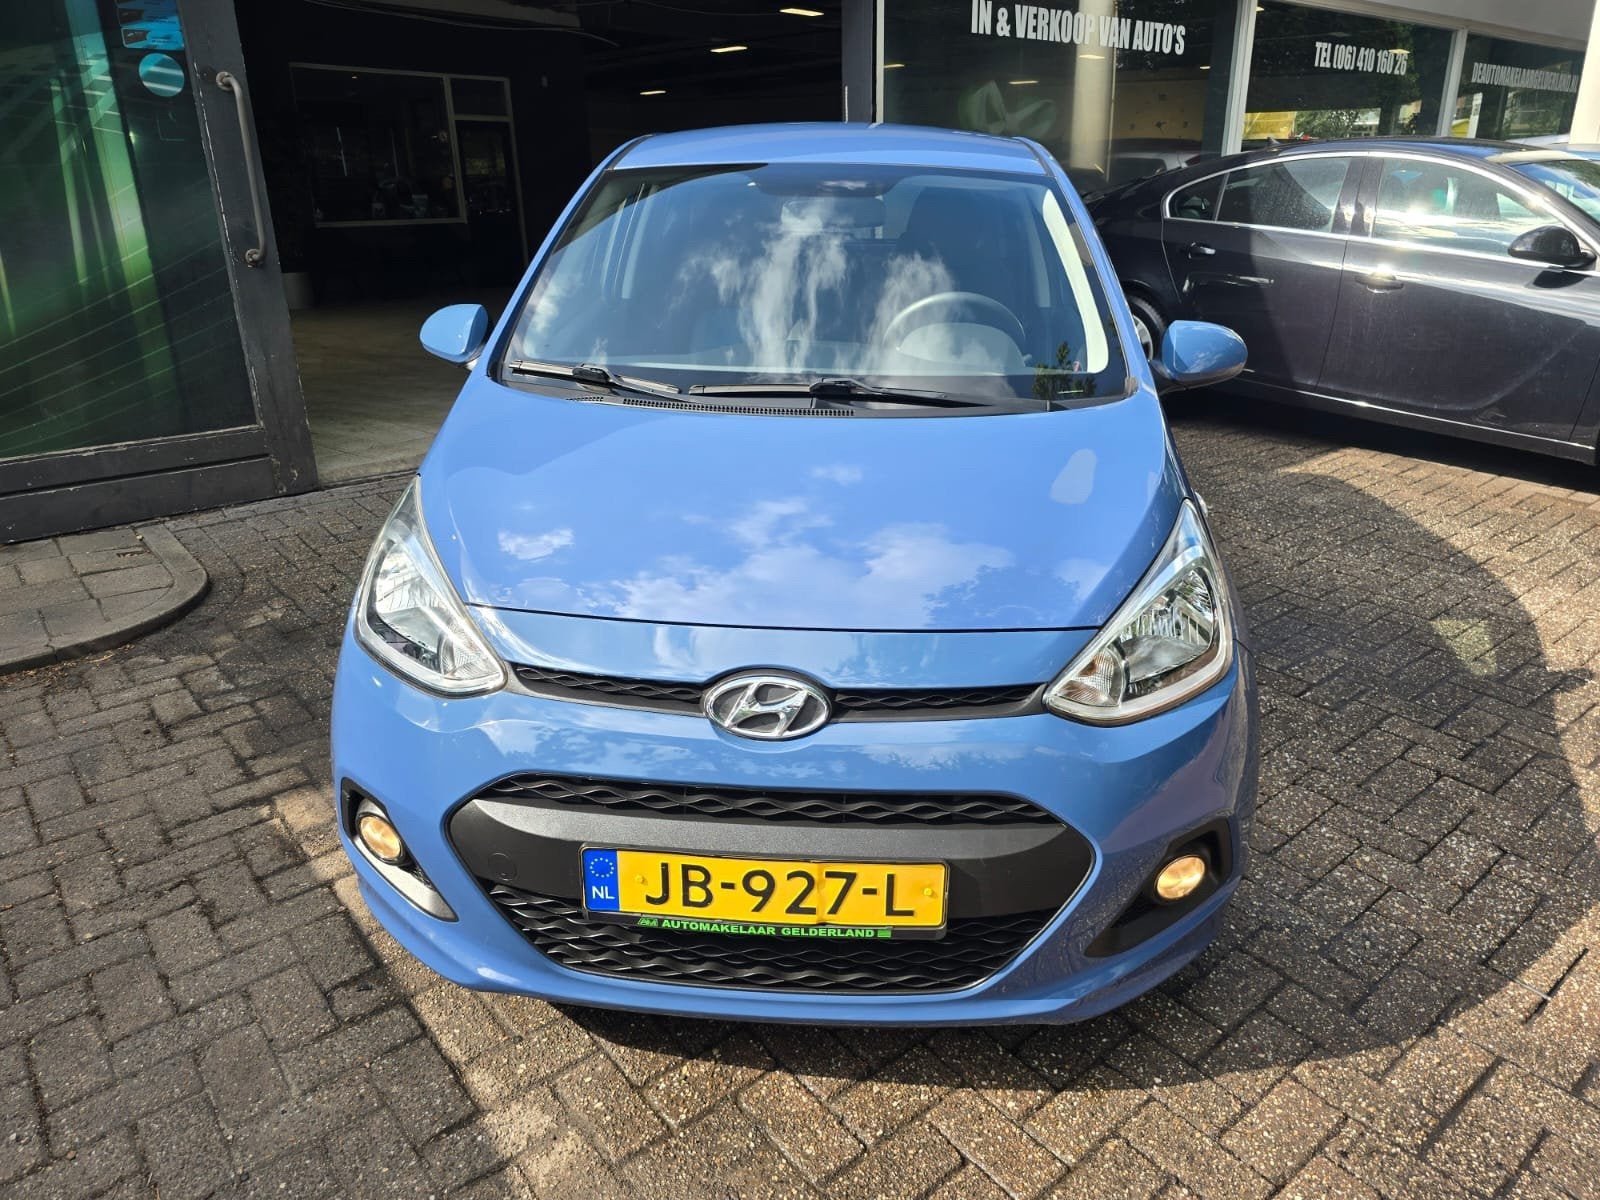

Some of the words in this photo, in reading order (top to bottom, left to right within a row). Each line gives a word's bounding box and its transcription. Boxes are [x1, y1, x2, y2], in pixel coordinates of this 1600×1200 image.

[971, 0, 992, 35] IN
[996, 7, 1011, 37] &
[1014, 4, 1095, 45] VERKOOP
[1099, 15, 1131, 49] VAN
[1132, 20, 1185, 55] AUTO'S
[1314, 41, 1332, 68] TEL
[1332, 44, 1356, 70] (06)
[1356, 46, 1375, 72] 410
[1376, 49, 1394, 74] 160
[1394, 51, 1408, 76] 26
[592, 886, 615, 900] NL
[645, 862, 914, 917] JB-927-L
[661, 919, 776, 936] AUTOMAKELAAR
[782, 926, 874, 939] GELDERLAND
